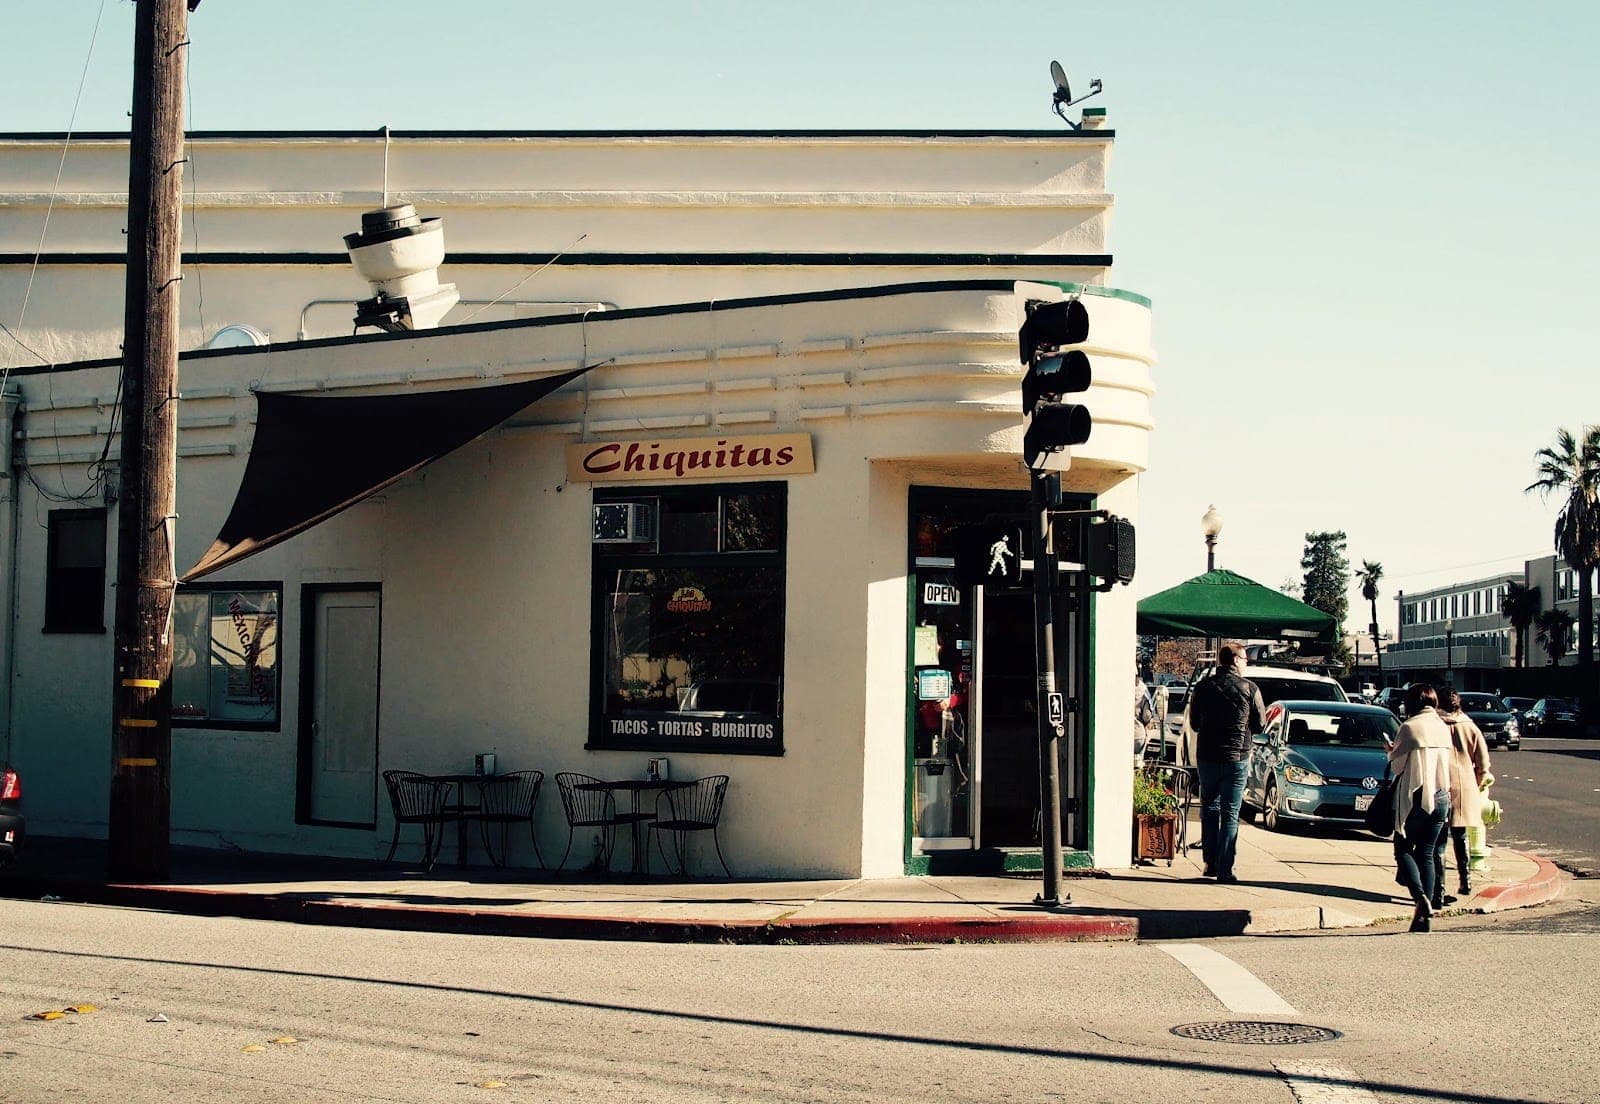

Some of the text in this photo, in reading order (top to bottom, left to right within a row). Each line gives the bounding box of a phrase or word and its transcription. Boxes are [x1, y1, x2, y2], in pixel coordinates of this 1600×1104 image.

[583, 440, 795, 477] Chiquitas
[927, 585, 957, 603] OPEN
[611, 719, 648, 735] TACOS
[657, 721, 703, 737] TORTAS
[711, 723, 774, 739] BURRITOS
